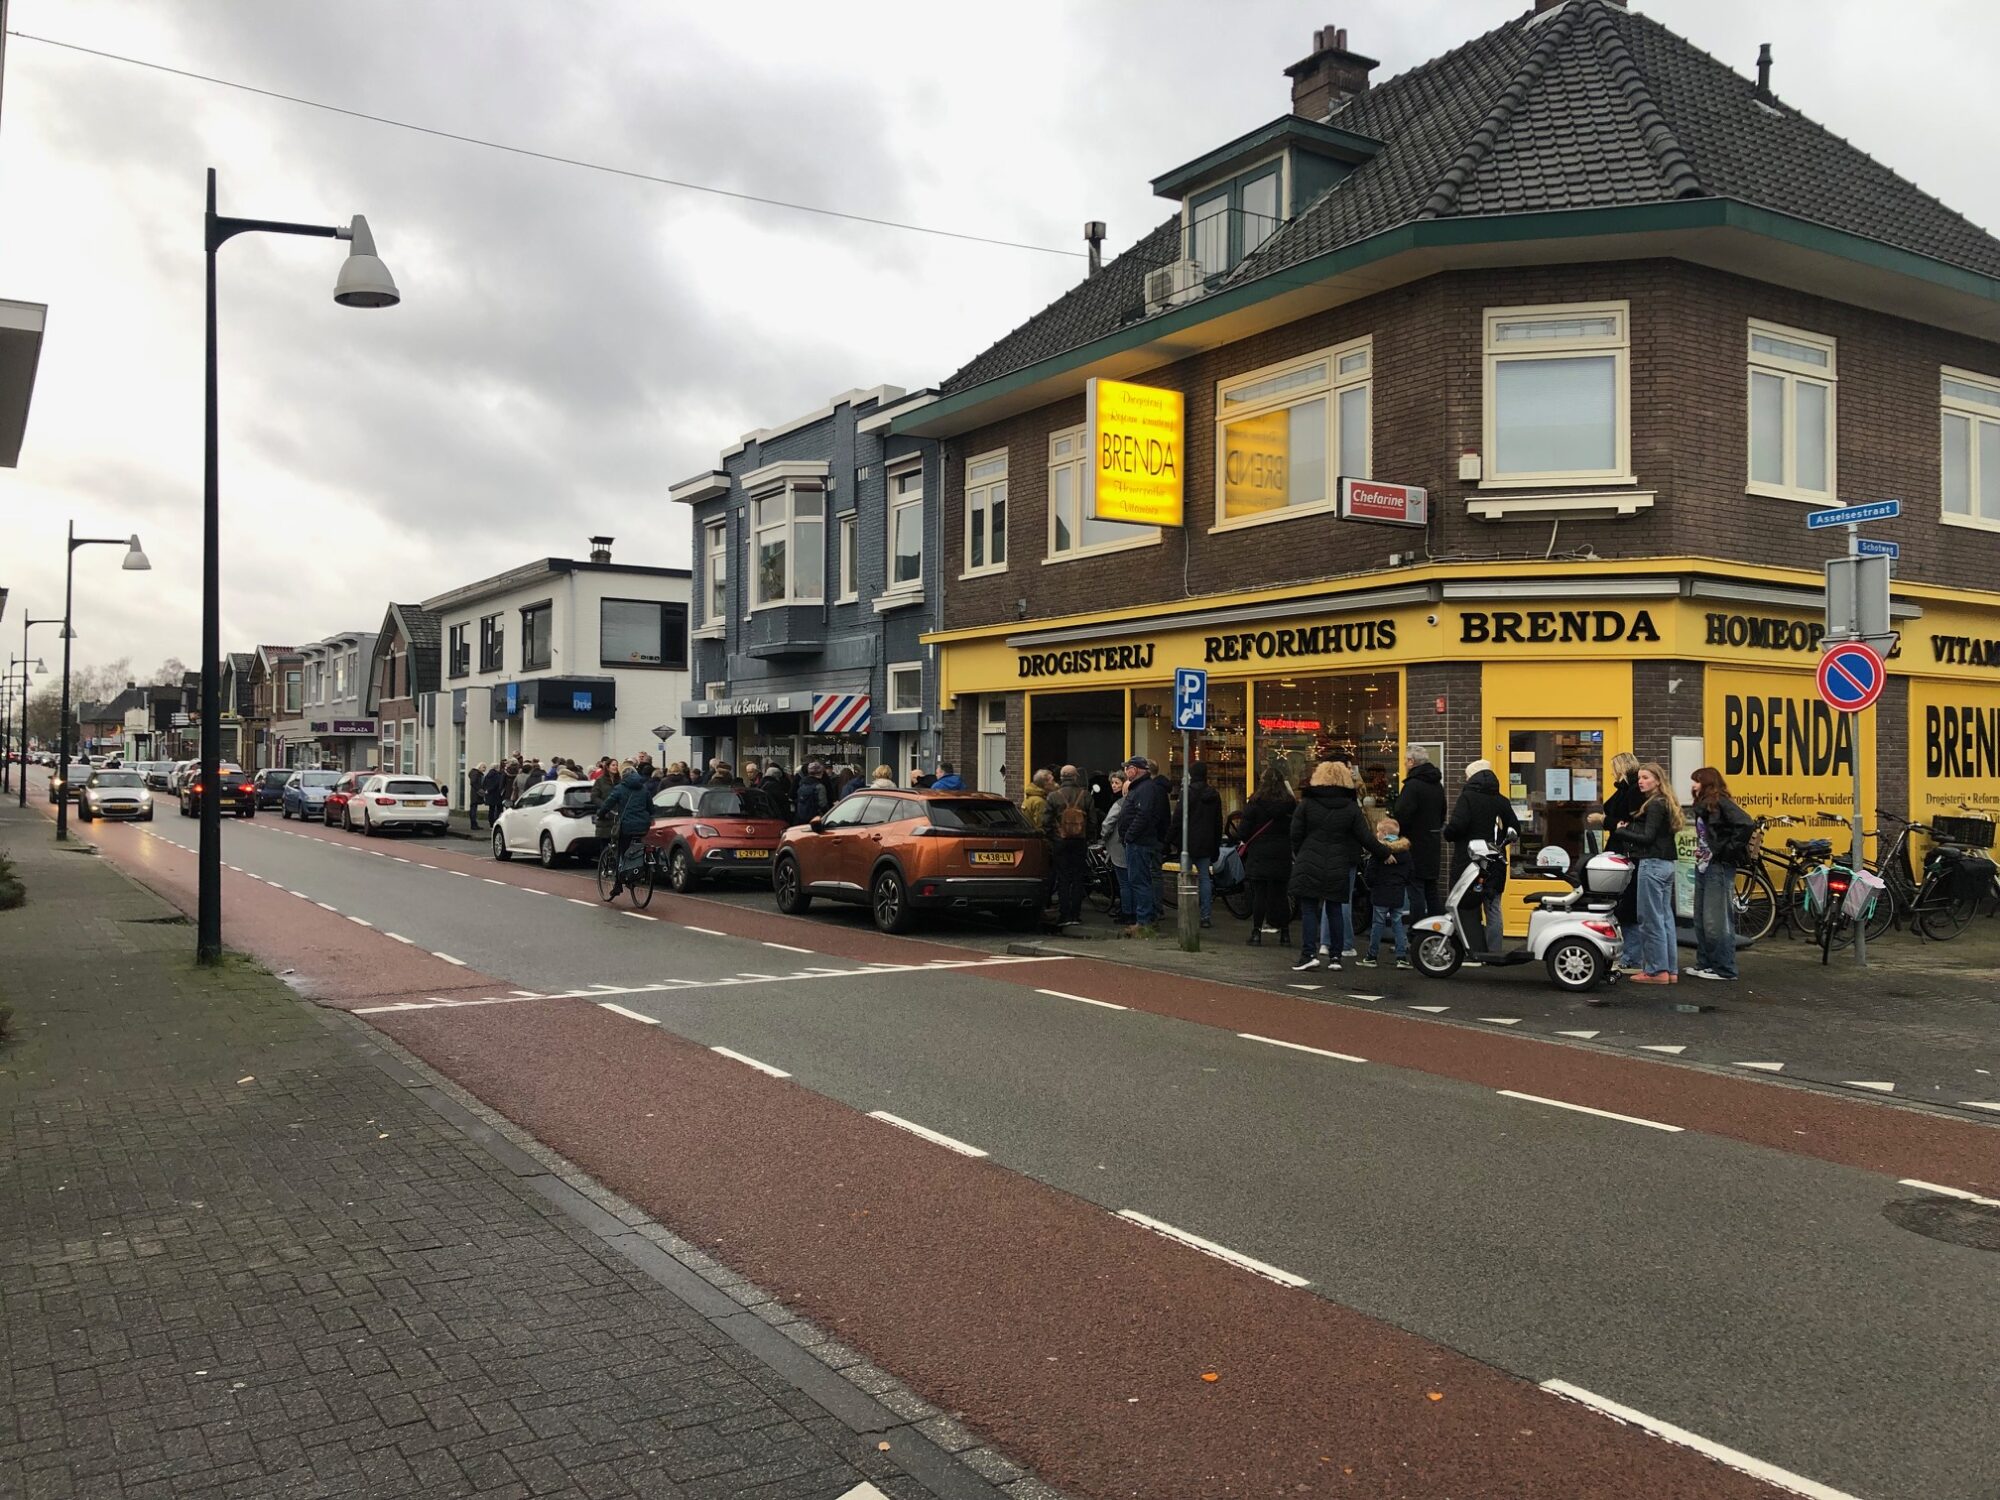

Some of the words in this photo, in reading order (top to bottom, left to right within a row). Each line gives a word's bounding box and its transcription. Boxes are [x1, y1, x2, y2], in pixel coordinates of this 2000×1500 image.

[1102, 432, 1176, 478] BRENDA
[1352, 489, 1404, 507] Chefarine
[1815, 505, 1892, 524] Asselsestraat
[1861, 542, 1894, 556] Schotweg
[1204, 620, 1397, 664] REFORMHUIS
[1459, 610, 1661, 643] BRENDA
[1705, 613, 1902, 660] HOMEOPE
[1018, 643, 1155, 678] DROGISTERIJ
[1184, 674, 1201, 704] P
[1725, 694, 1855, 777] BRENDA
[1926, 705, 2000, 778] BREN
[1781, 792, 1855, 806] Reform-Kruideri
[1926, 793, 1966, 808] Drogisterij
[977, 853, 1012, 862] K-438-LV
